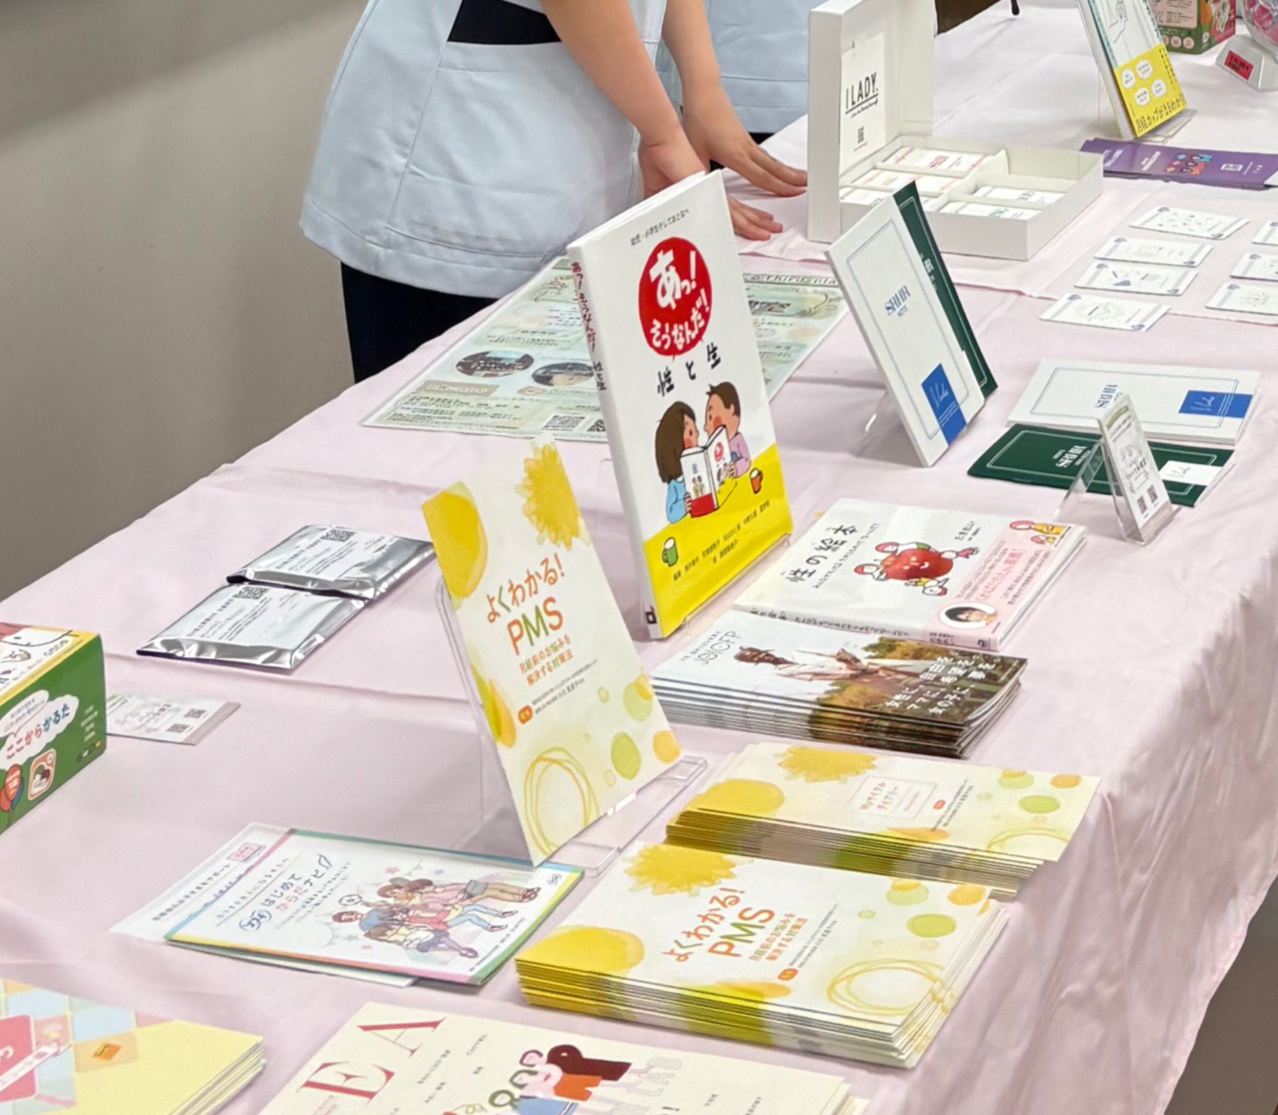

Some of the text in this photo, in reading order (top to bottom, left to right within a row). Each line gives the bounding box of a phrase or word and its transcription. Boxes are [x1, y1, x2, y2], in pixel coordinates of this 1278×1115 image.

[786, 524, 857, 583] 性の絵本
[506, 596, 563, 656] PMS
[6, 703, 70, 760] ここからかるた
[260, 873, 302, 908] はじめて
[708, 907, 775, 958] PMS
